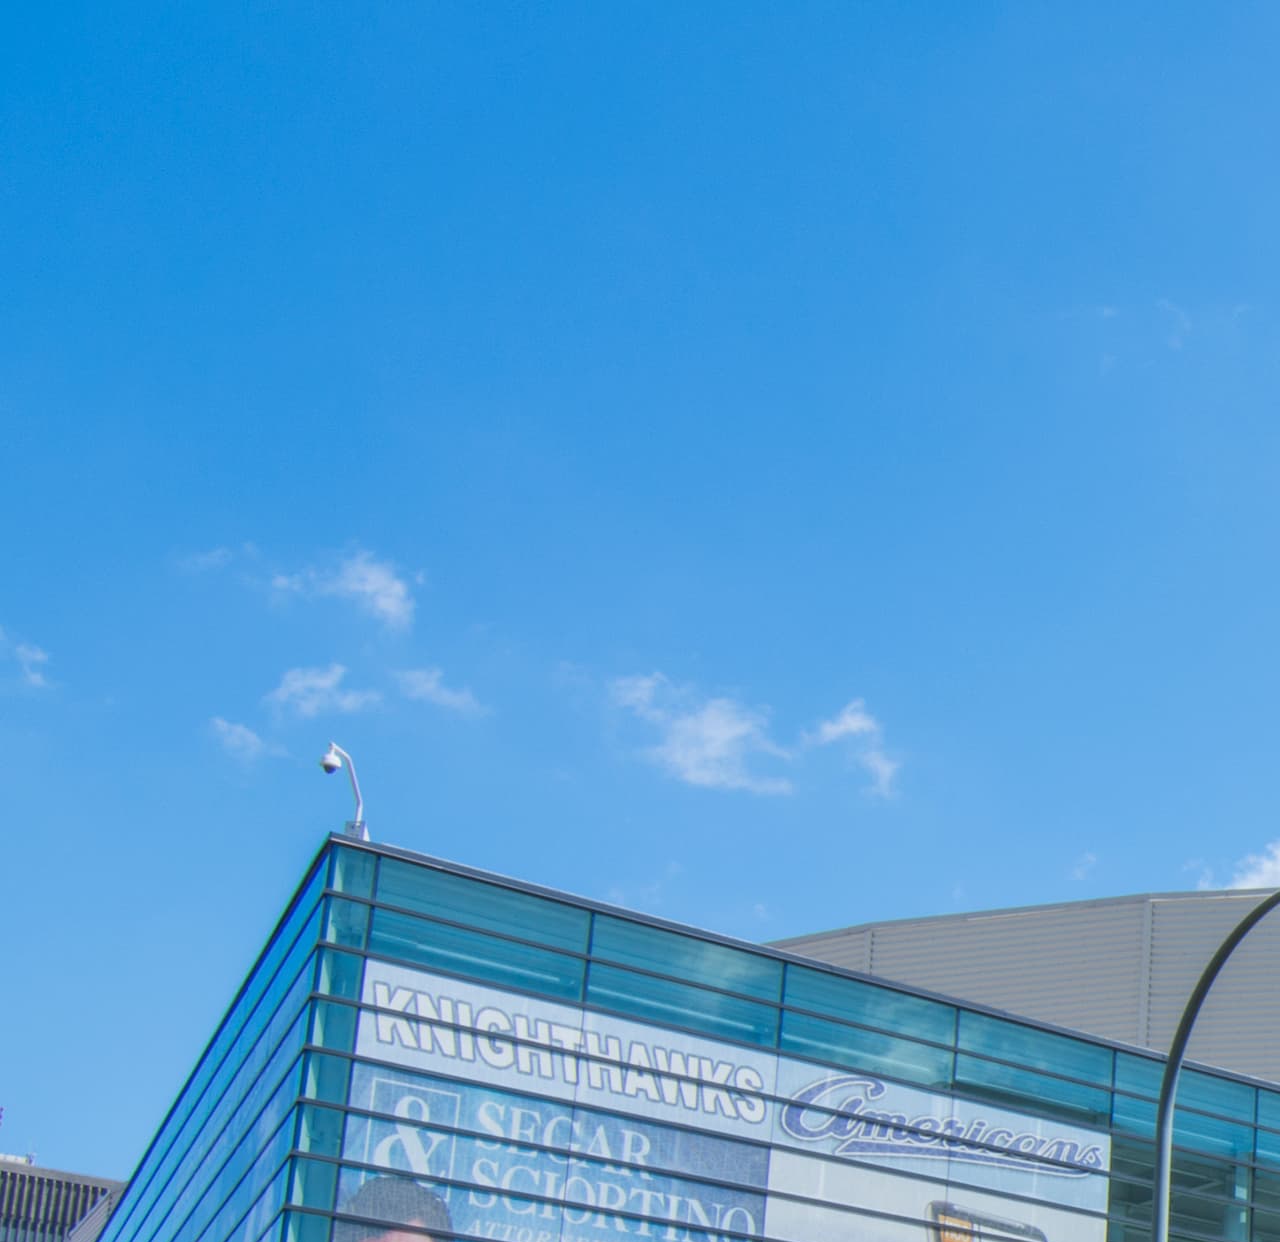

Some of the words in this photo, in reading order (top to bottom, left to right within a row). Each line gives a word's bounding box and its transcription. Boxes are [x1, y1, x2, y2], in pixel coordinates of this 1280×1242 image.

[372, 981, 768, 1125] KNIGHTHAWKS
[475, 1099, 654, 1181] SEGAR
[780, 1074, 1105, 1172] Americans
